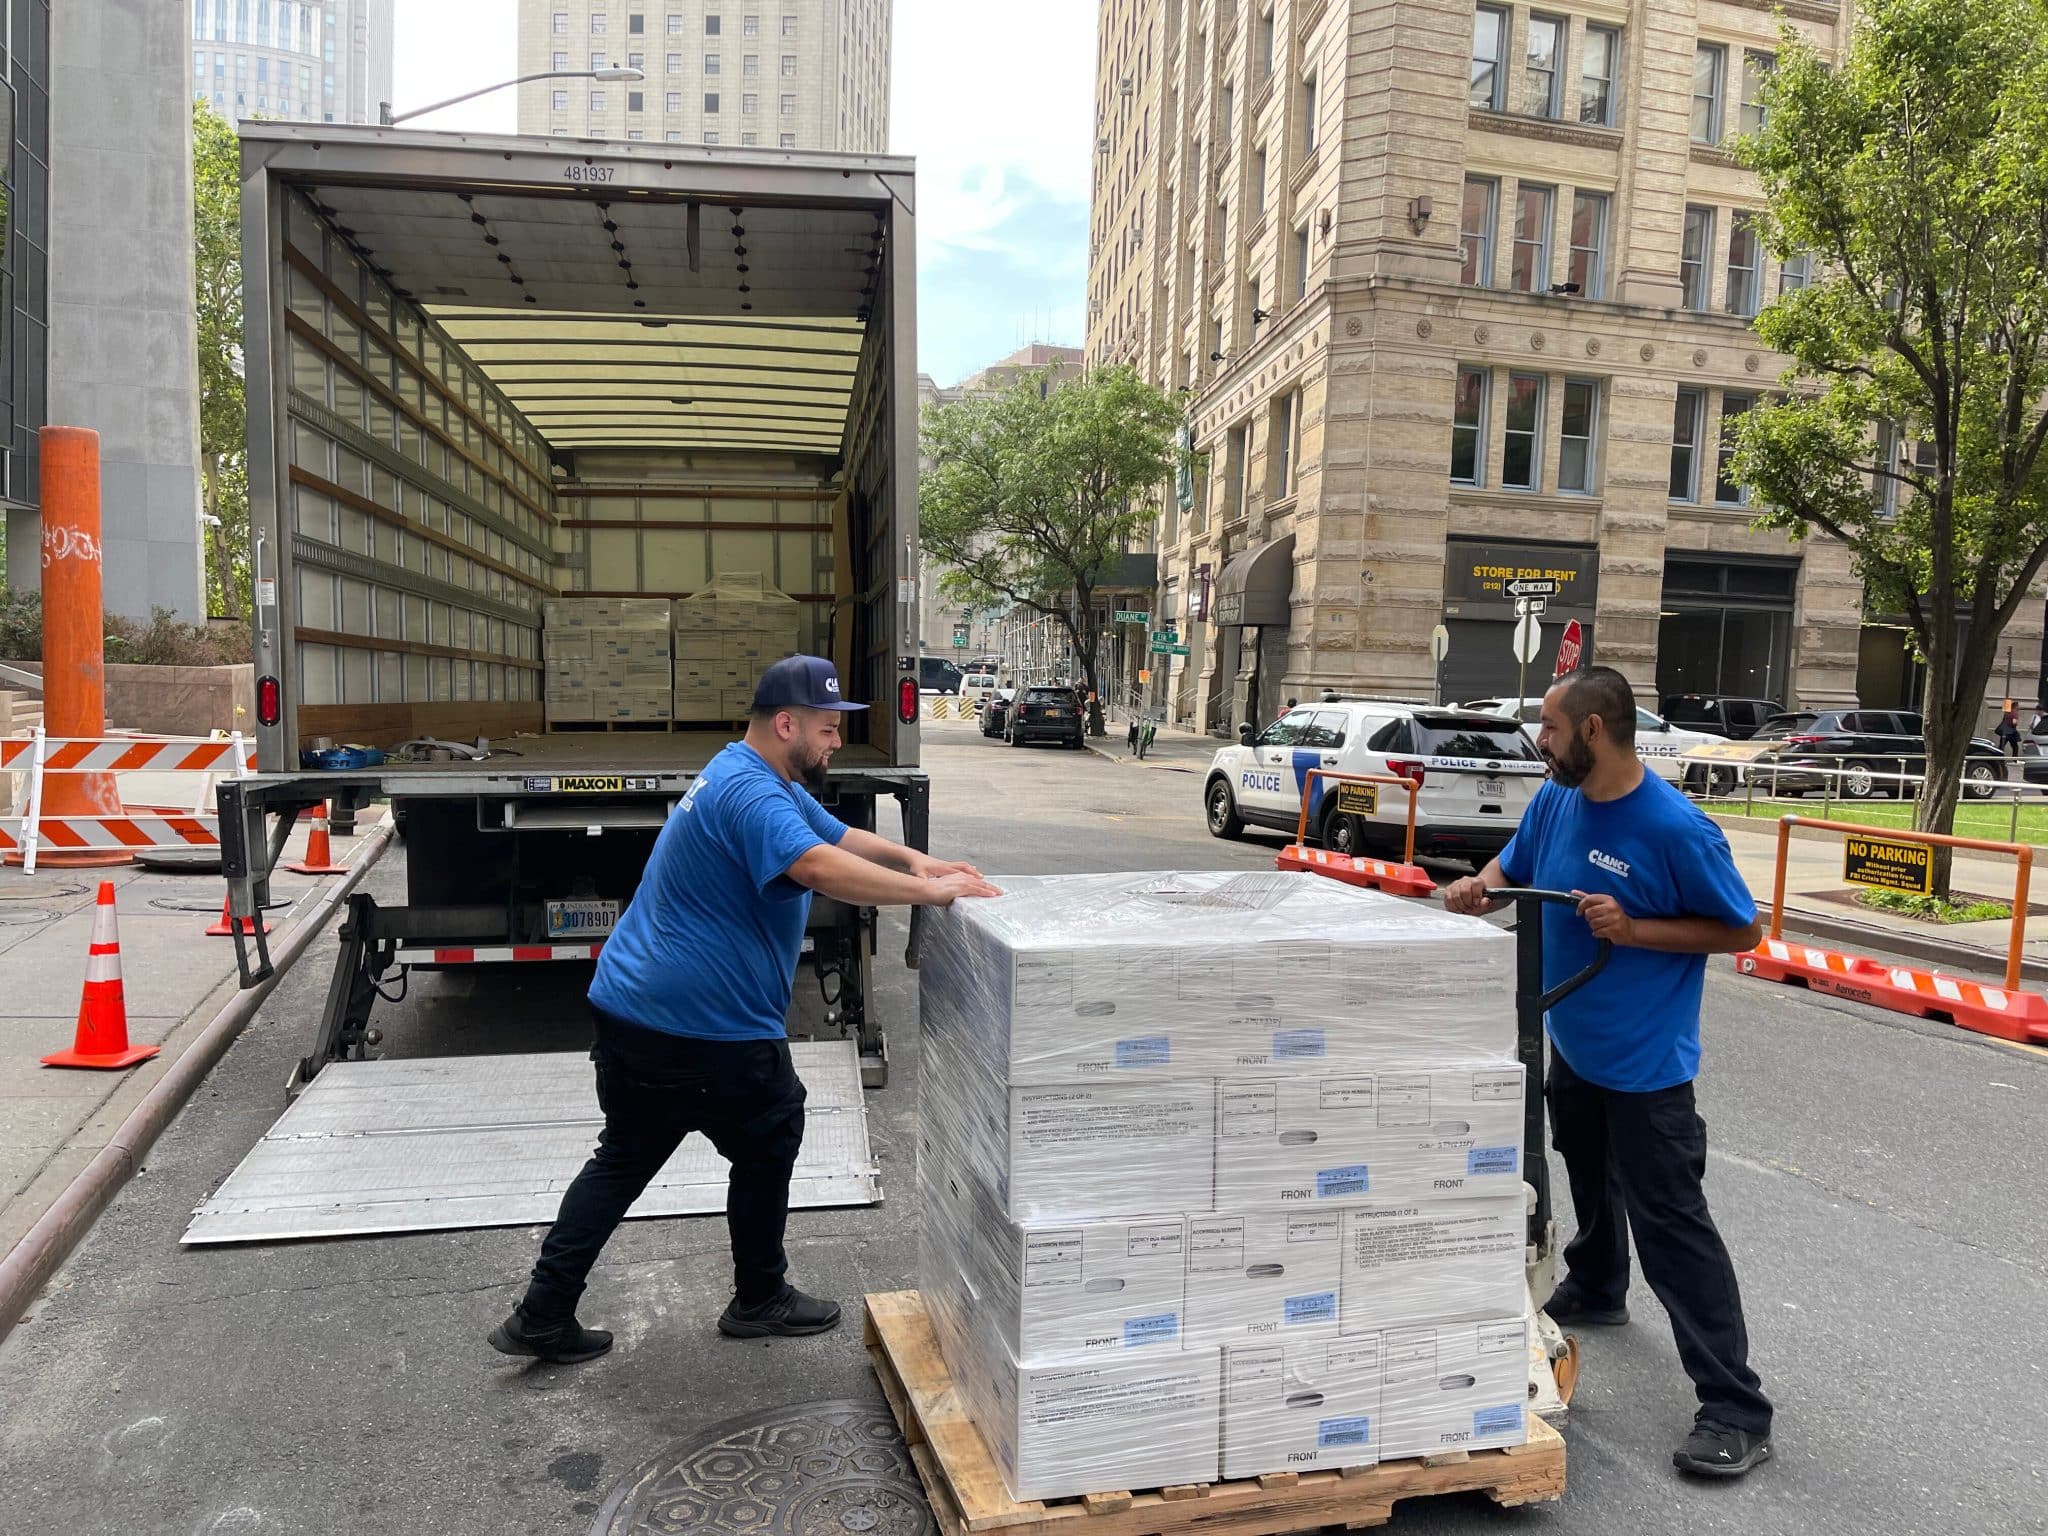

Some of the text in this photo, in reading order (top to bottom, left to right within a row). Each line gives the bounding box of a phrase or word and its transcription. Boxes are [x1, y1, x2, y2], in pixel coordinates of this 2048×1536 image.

[563, 165, 614, 182] 481937
[1473, 566, 1577, 581] STORE FOR RENT
[1483, 581, 1501, 590] (212)
[1533, 583, 1549, 591] WAY
[1115, 612, 1139, 621] DUANE
[1560, 639, 1580, 666] STOP
[1431, 757, 1477, 768] POLICE
[564, 778, 618, 790] MAXON
[1242, 773, 1280, 792] POLICE
[1340, 785, 1349, 794] NO
[1849, 842, 1926, 866] NO PARKING
[1588, 849, 1631, 873] CLANCY
[1865, 861, 1907, 873] Without prior
[1856, 867, 1915, 882] authorization from
[1237, 1055, 1269, 1065] FRONT
[1076, 1062, 1110, 1073] FRONT
[1433, 1179, 1465, 1189] FRONT
[1281, 1189, 1312, 1200] FRONT
[1247, 1321, 1279, 1333] FRONT
[1085, 1337, 1118, 1348] FRONT
[1440, 1431, 1470, 1443] FRONT
[1287, 1451, 1319, 1462] FRONT
